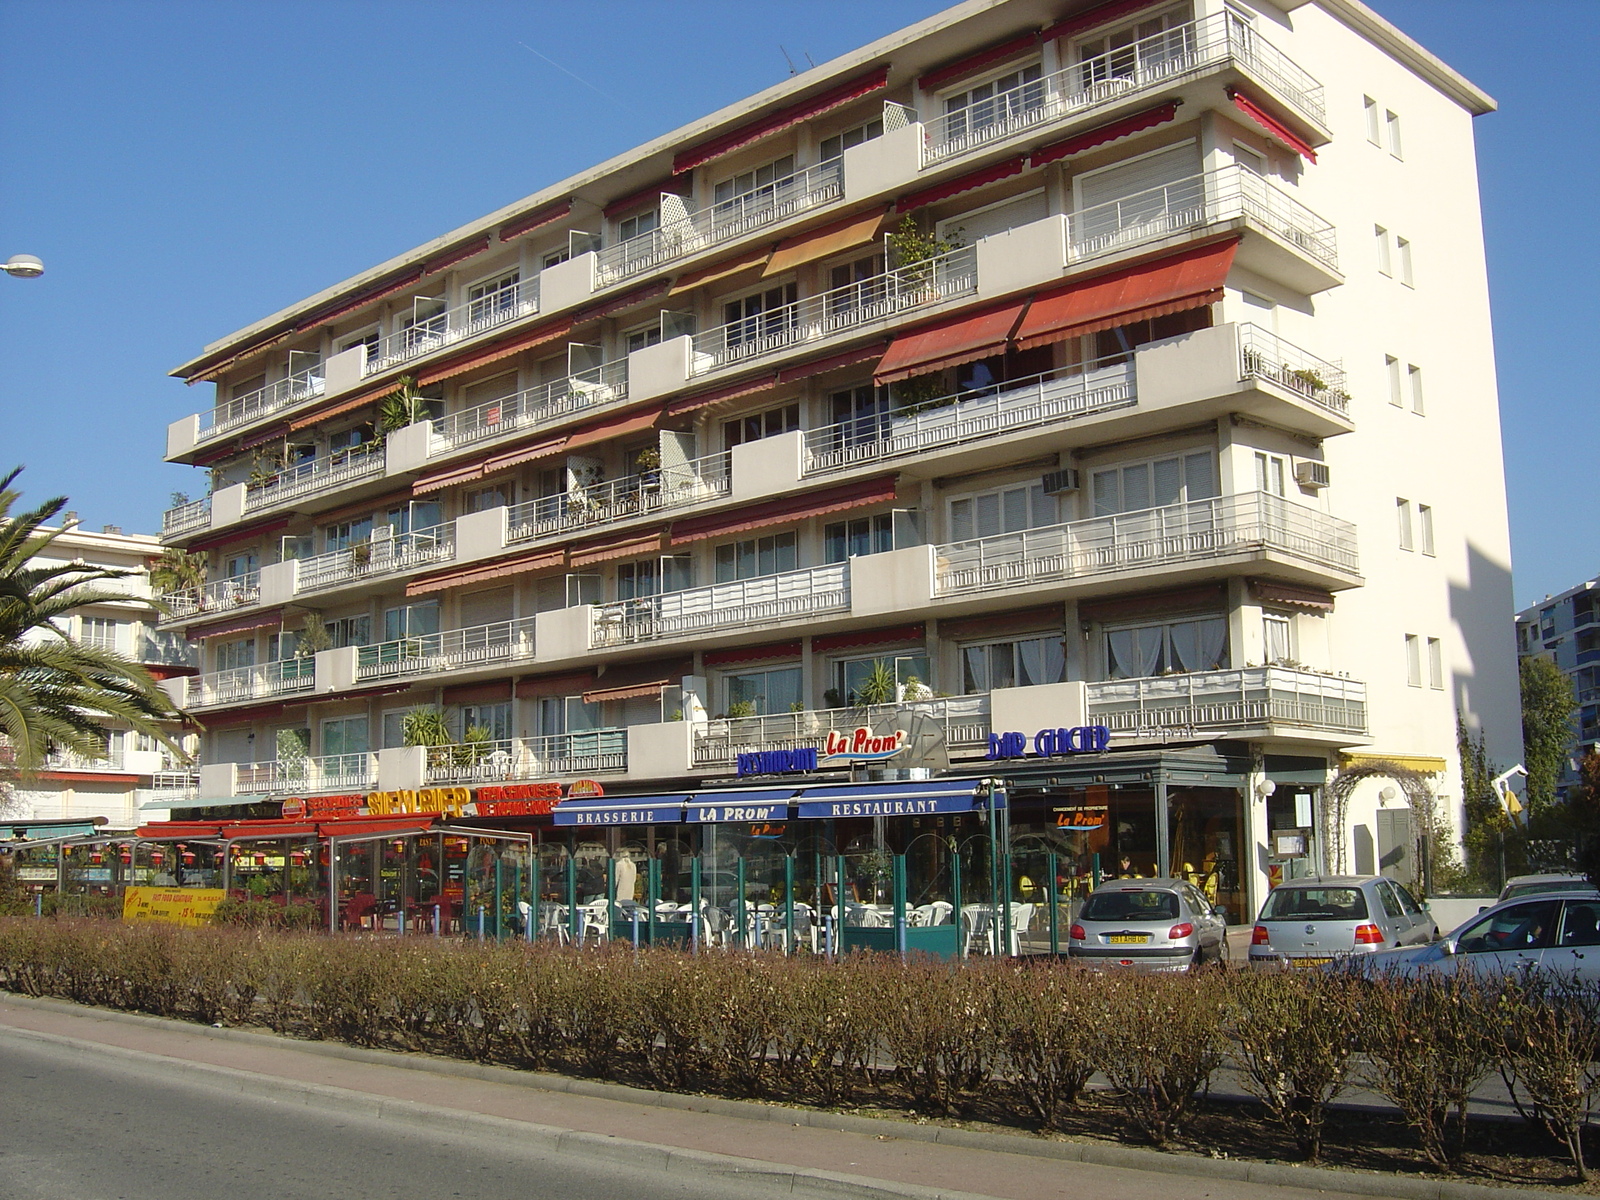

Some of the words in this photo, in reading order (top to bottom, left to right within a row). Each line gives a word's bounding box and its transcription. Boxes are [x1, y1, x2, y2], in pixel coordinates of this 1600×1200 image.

[826, 730, 849, 756] La
[852, 726, 907, 754] Prom'
[985, 732, 1027, 760] BAR
[1034, 725, 1111, 757] GLACIER
[1136, 724, 1198, 744] Crêperie
[737, 748, 818, 778] RESTAURANT
[699, 808, 717, 821] LA
[724, 806, 775, 821] PROM'
[832, 800, 937, 815] RESTAURANT
[577, 810, 654, 823] BRASSERIE
[1057, 813, 1070, 826] La
[1073, 812, 1105, 826] Prom'
